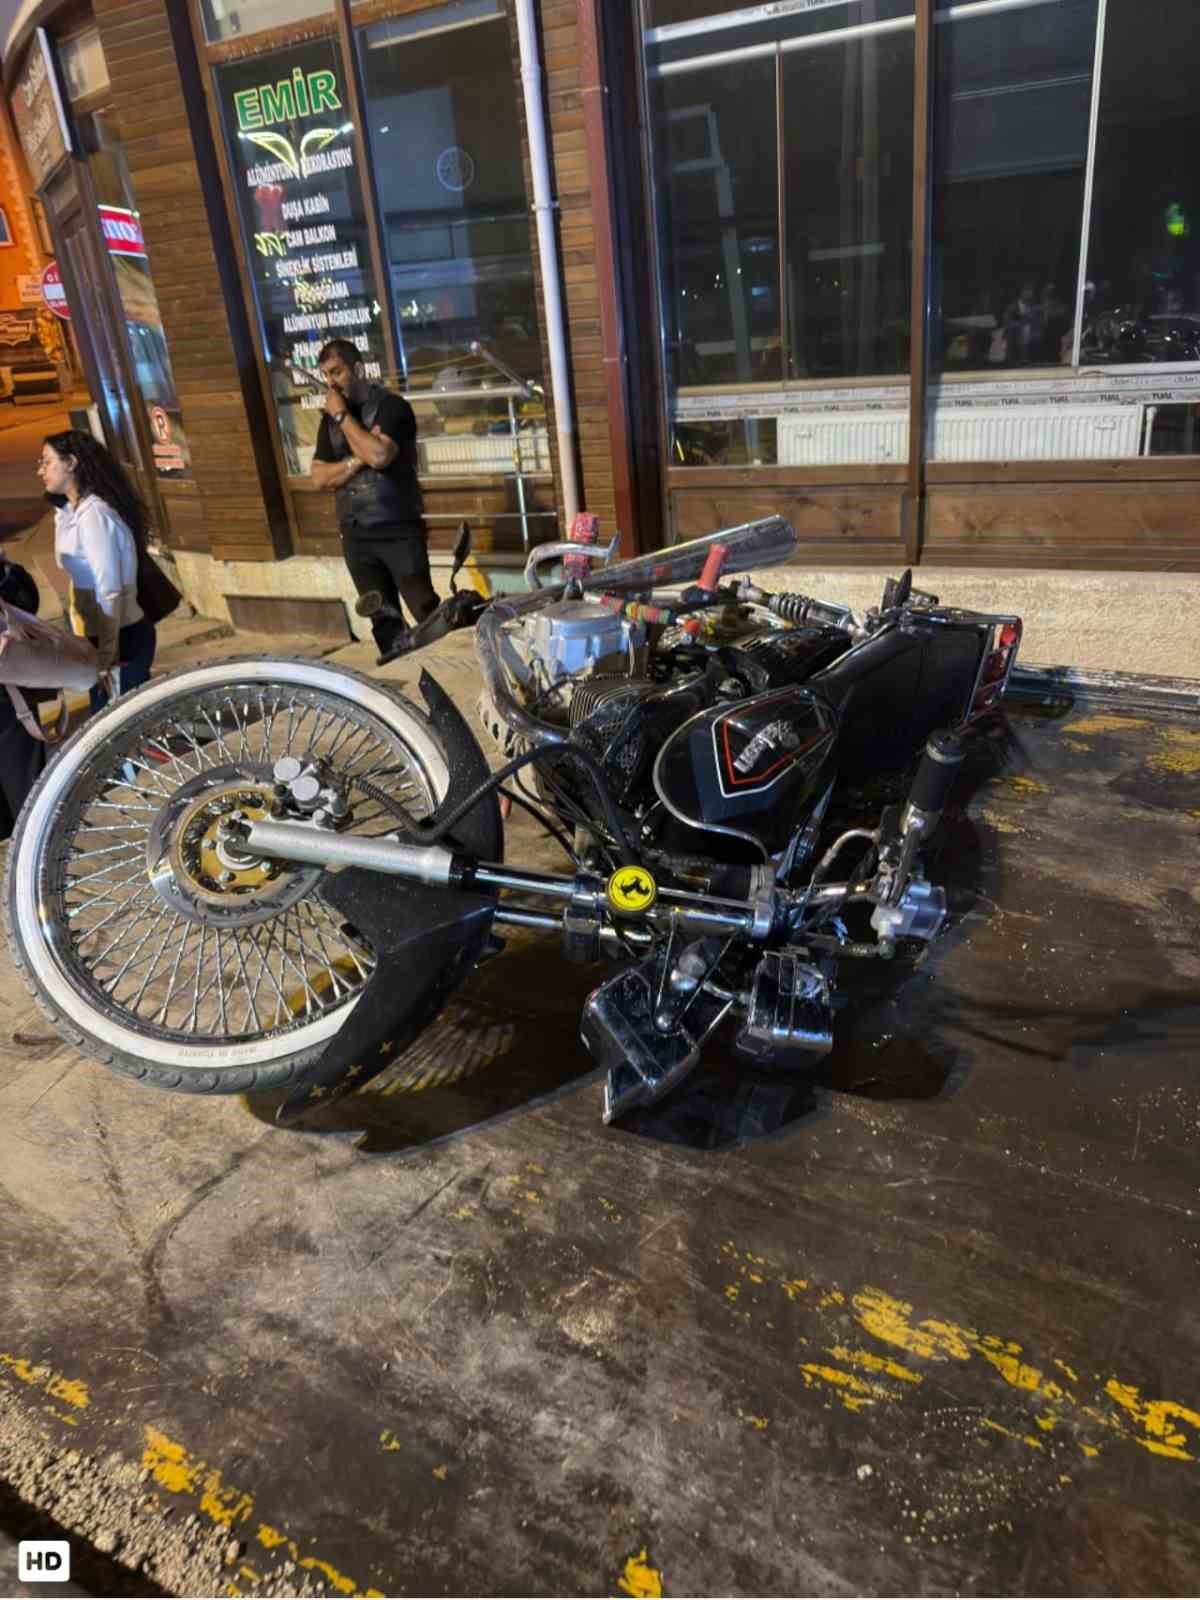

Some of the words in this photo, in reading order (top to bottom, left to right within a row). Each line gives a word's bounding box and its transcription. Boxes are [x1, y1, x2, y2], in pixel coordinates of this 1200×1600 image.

[233, 66, 342, 131] EMİR
[303, 191, 330, 216] KABİN
[286, 229, 304, 248] CAM
[303, 223, 337, 245] BALKON
[311, 240, 358, 273] SİSTEMLERİ
